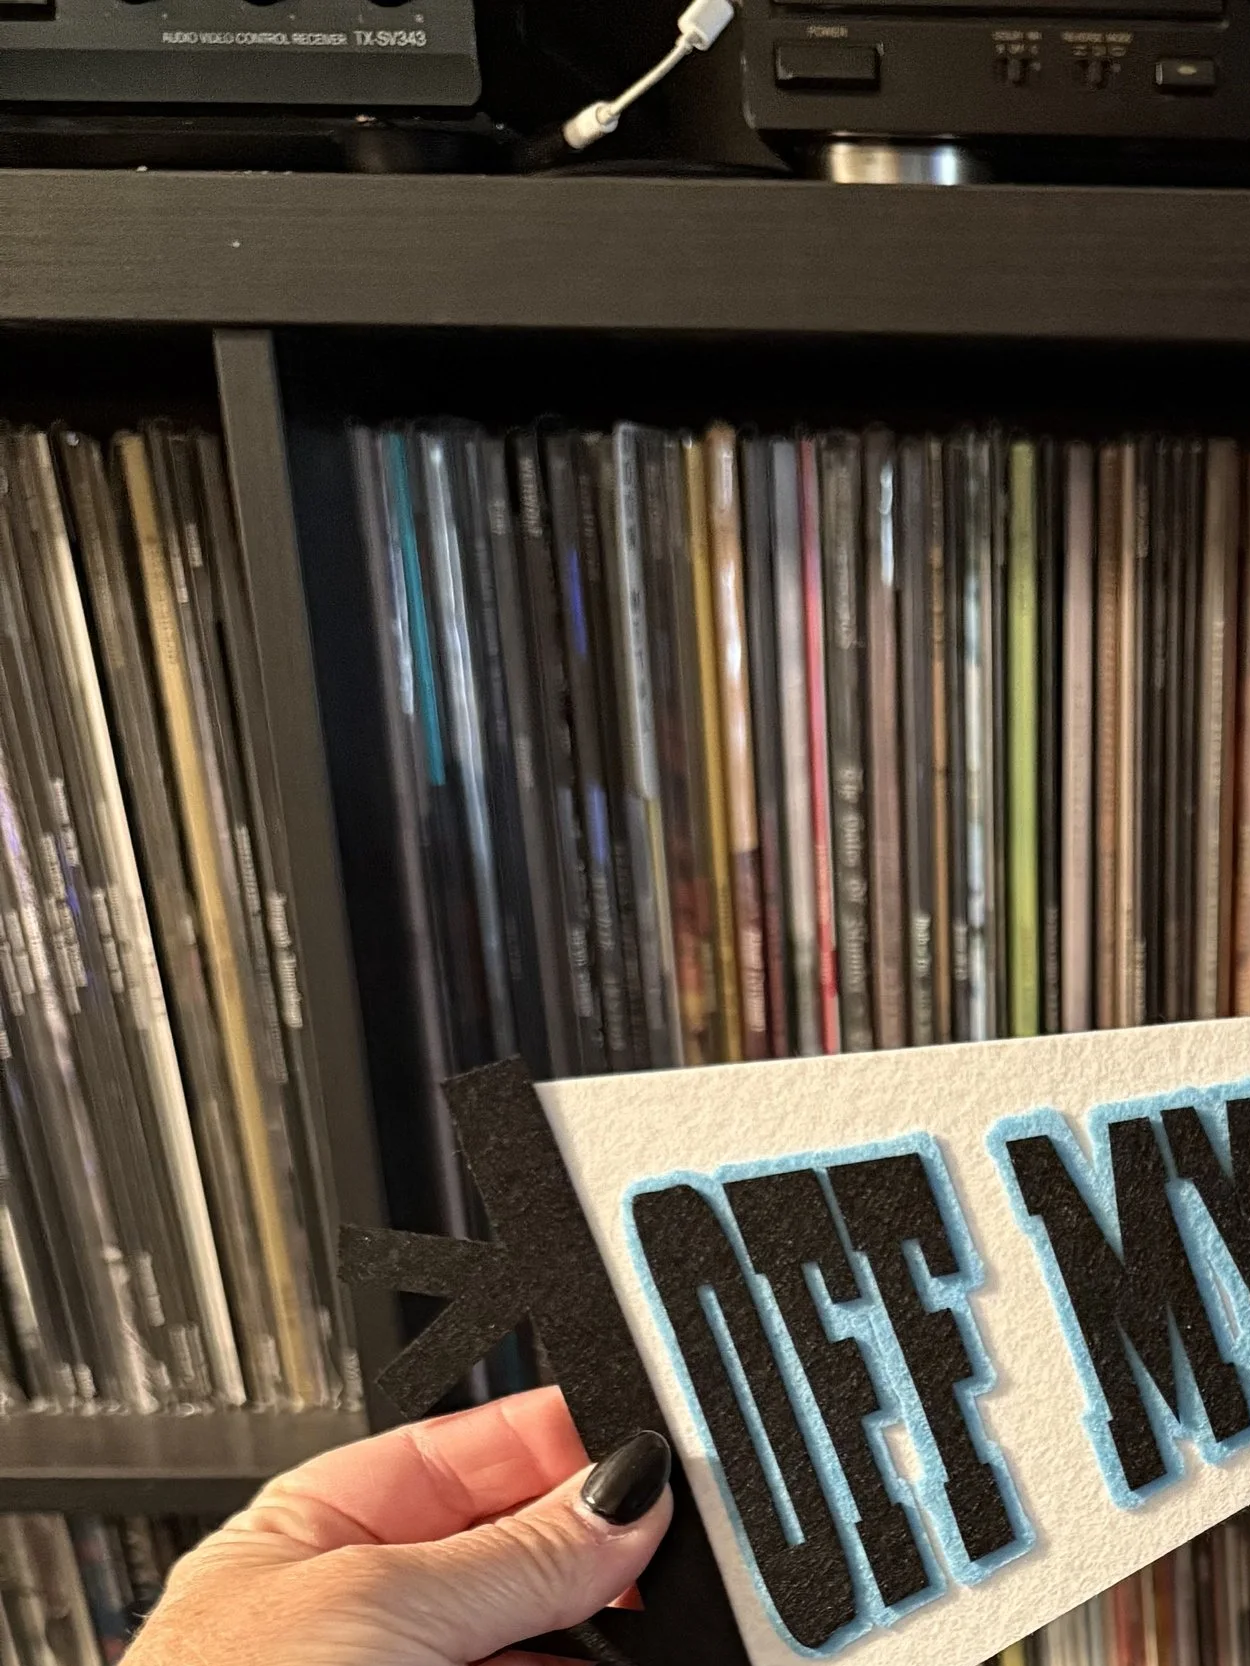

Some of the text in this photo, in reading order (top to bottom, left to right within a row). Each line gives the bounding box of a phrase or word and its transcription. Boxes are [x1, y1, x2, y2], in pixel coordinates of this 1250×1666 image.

[162, 30, 427, 47] AUDIO VIDEO CONTROL RECEIVER TX-SV343
[630, 1150, 1020, 1652] OFF
